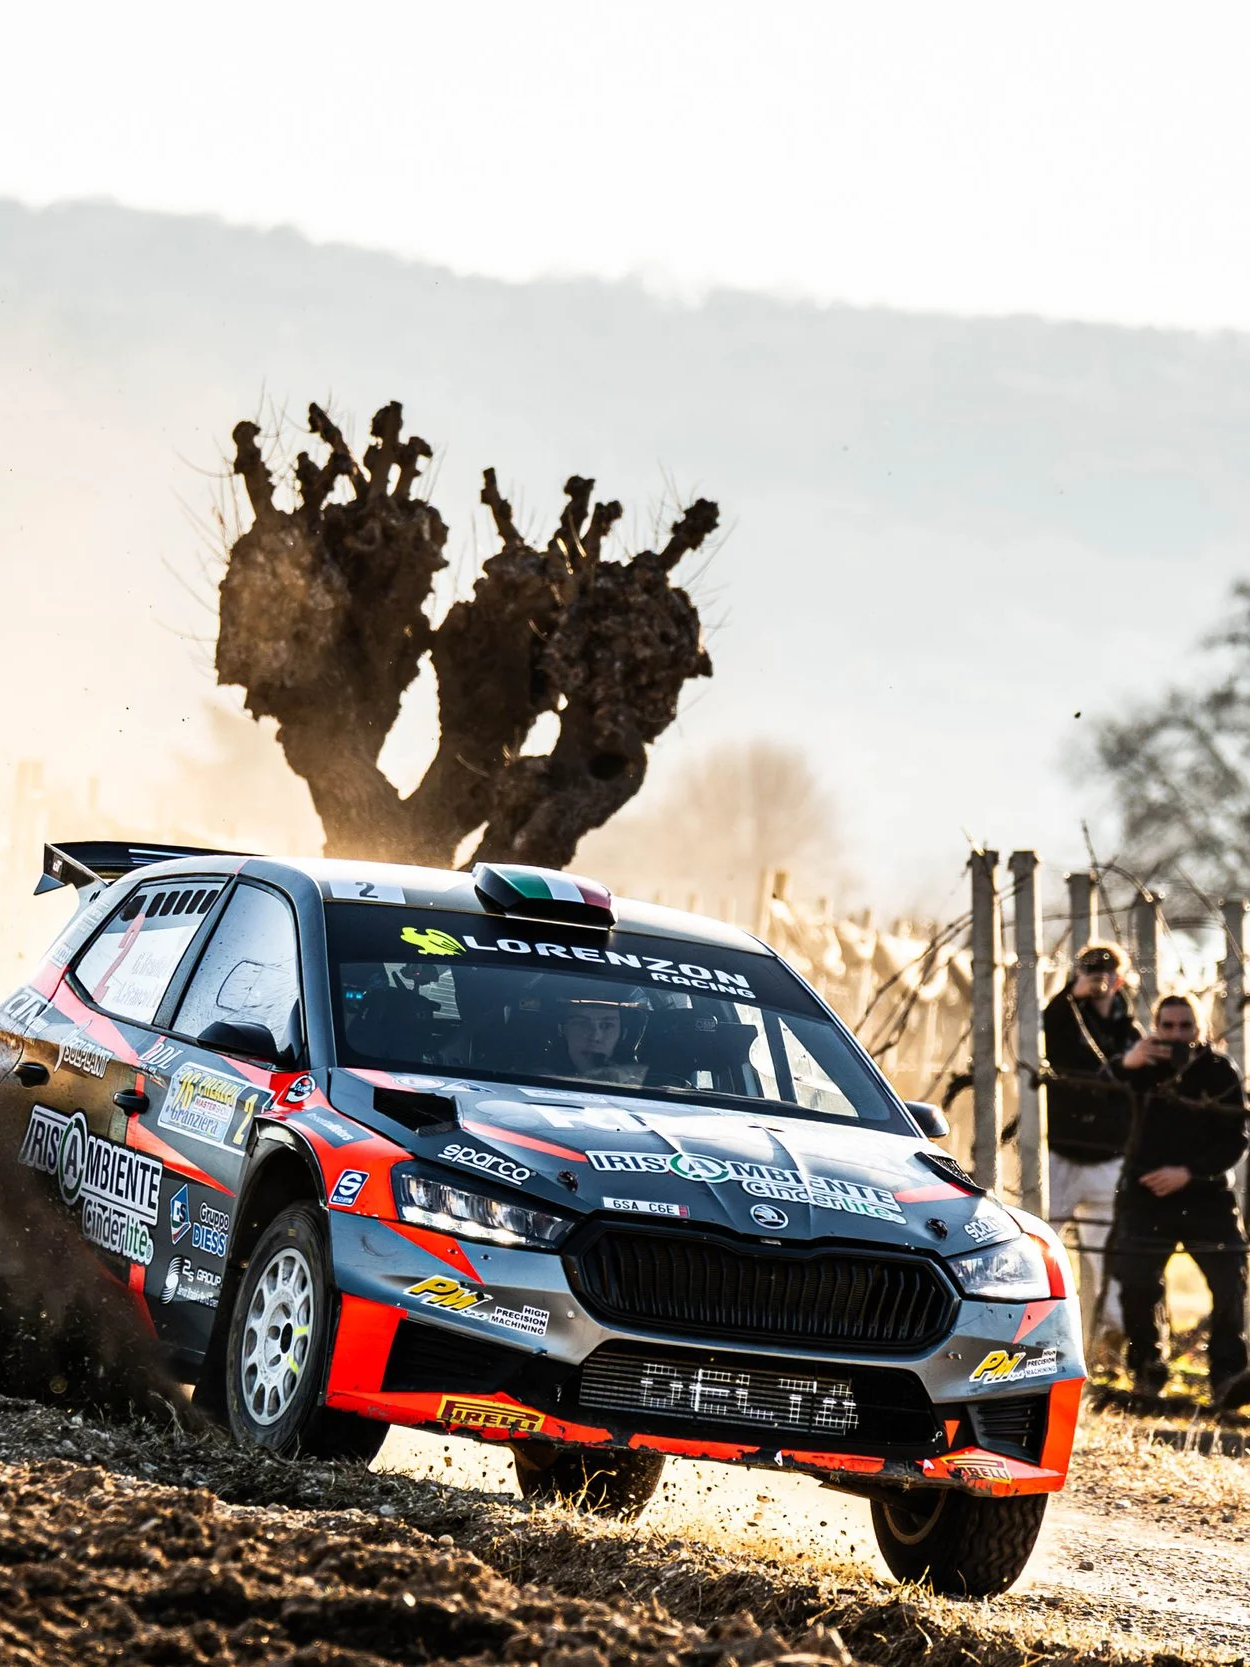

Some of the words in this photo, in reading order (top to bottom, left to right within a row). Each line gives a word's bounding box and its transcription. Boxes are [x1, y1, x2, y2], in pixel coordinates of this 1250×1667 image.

[355, 881, 378, 898] 2
[92, 912, 146, 1003] 2
[463, 935, 750, 988] LORENZON
[651, 972, 756, 999] RACING
[233, 1093, 259, 1145] 2
[441, 1144, 530, 1183] sparco
[200, 1202, 229, 1232] Gruppo
[197, 1269, 222, 1287] GROUP
[408, 1276, 483, 1312] PM
[491, 1315, 544, 1335] MACHINING
[496, 1308, 546, 1327] PRECISION
[524, 1307, 548, 1319] HIGH
[973, 1351, 1021, 1382] PM
[641, 1363, 859, 1434] DELTA
[441, 1399, 540, 1431] PIRELLI
